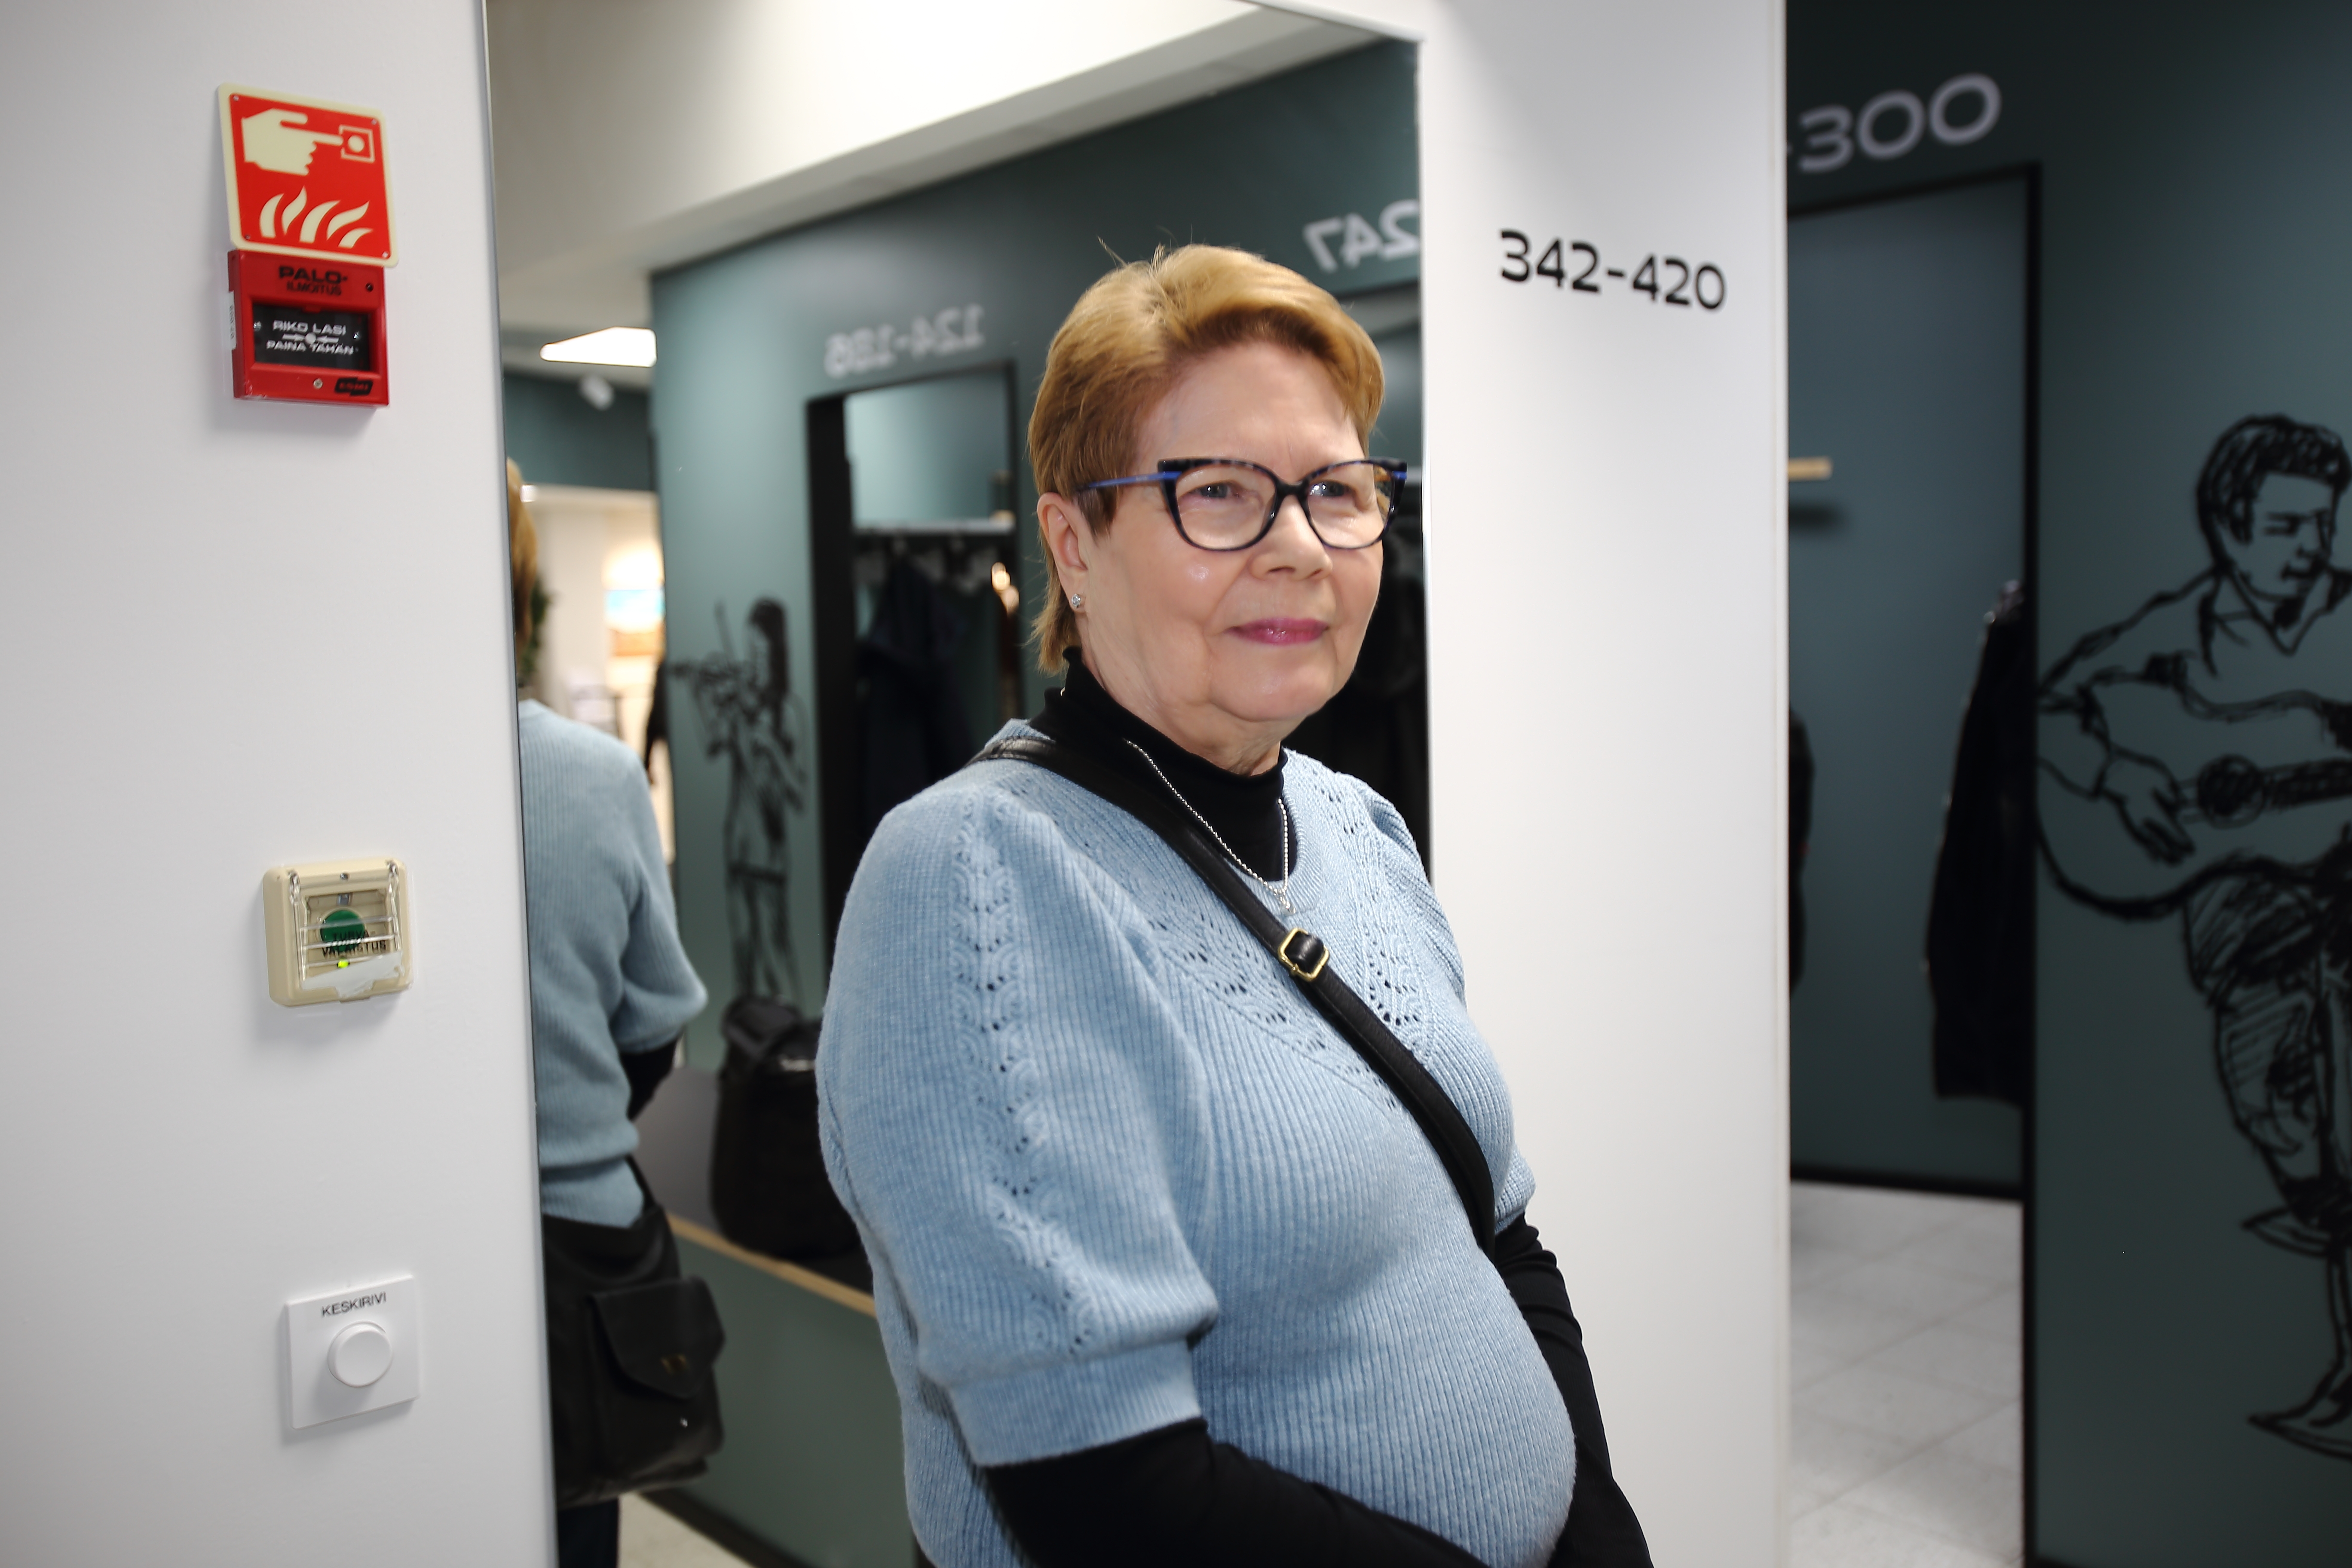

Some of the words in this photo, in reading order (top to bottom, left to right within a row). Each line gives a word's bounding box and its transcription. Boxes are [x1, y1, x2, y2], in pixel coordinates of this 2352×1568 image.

[1787, 73, 2002, 173] 300
[279, 265, 348, 285] PALO-
[1500, 229, 1727, 310] 342-420
[287, 281, 342, 296] ILMOITUS
[273, 320, 308, 333] RIKO
[312, 323, 346, 336] LASI
[266, 340, 306, 352] PAINA
[322, 1291, 386, 1317] KESKIRIVI
